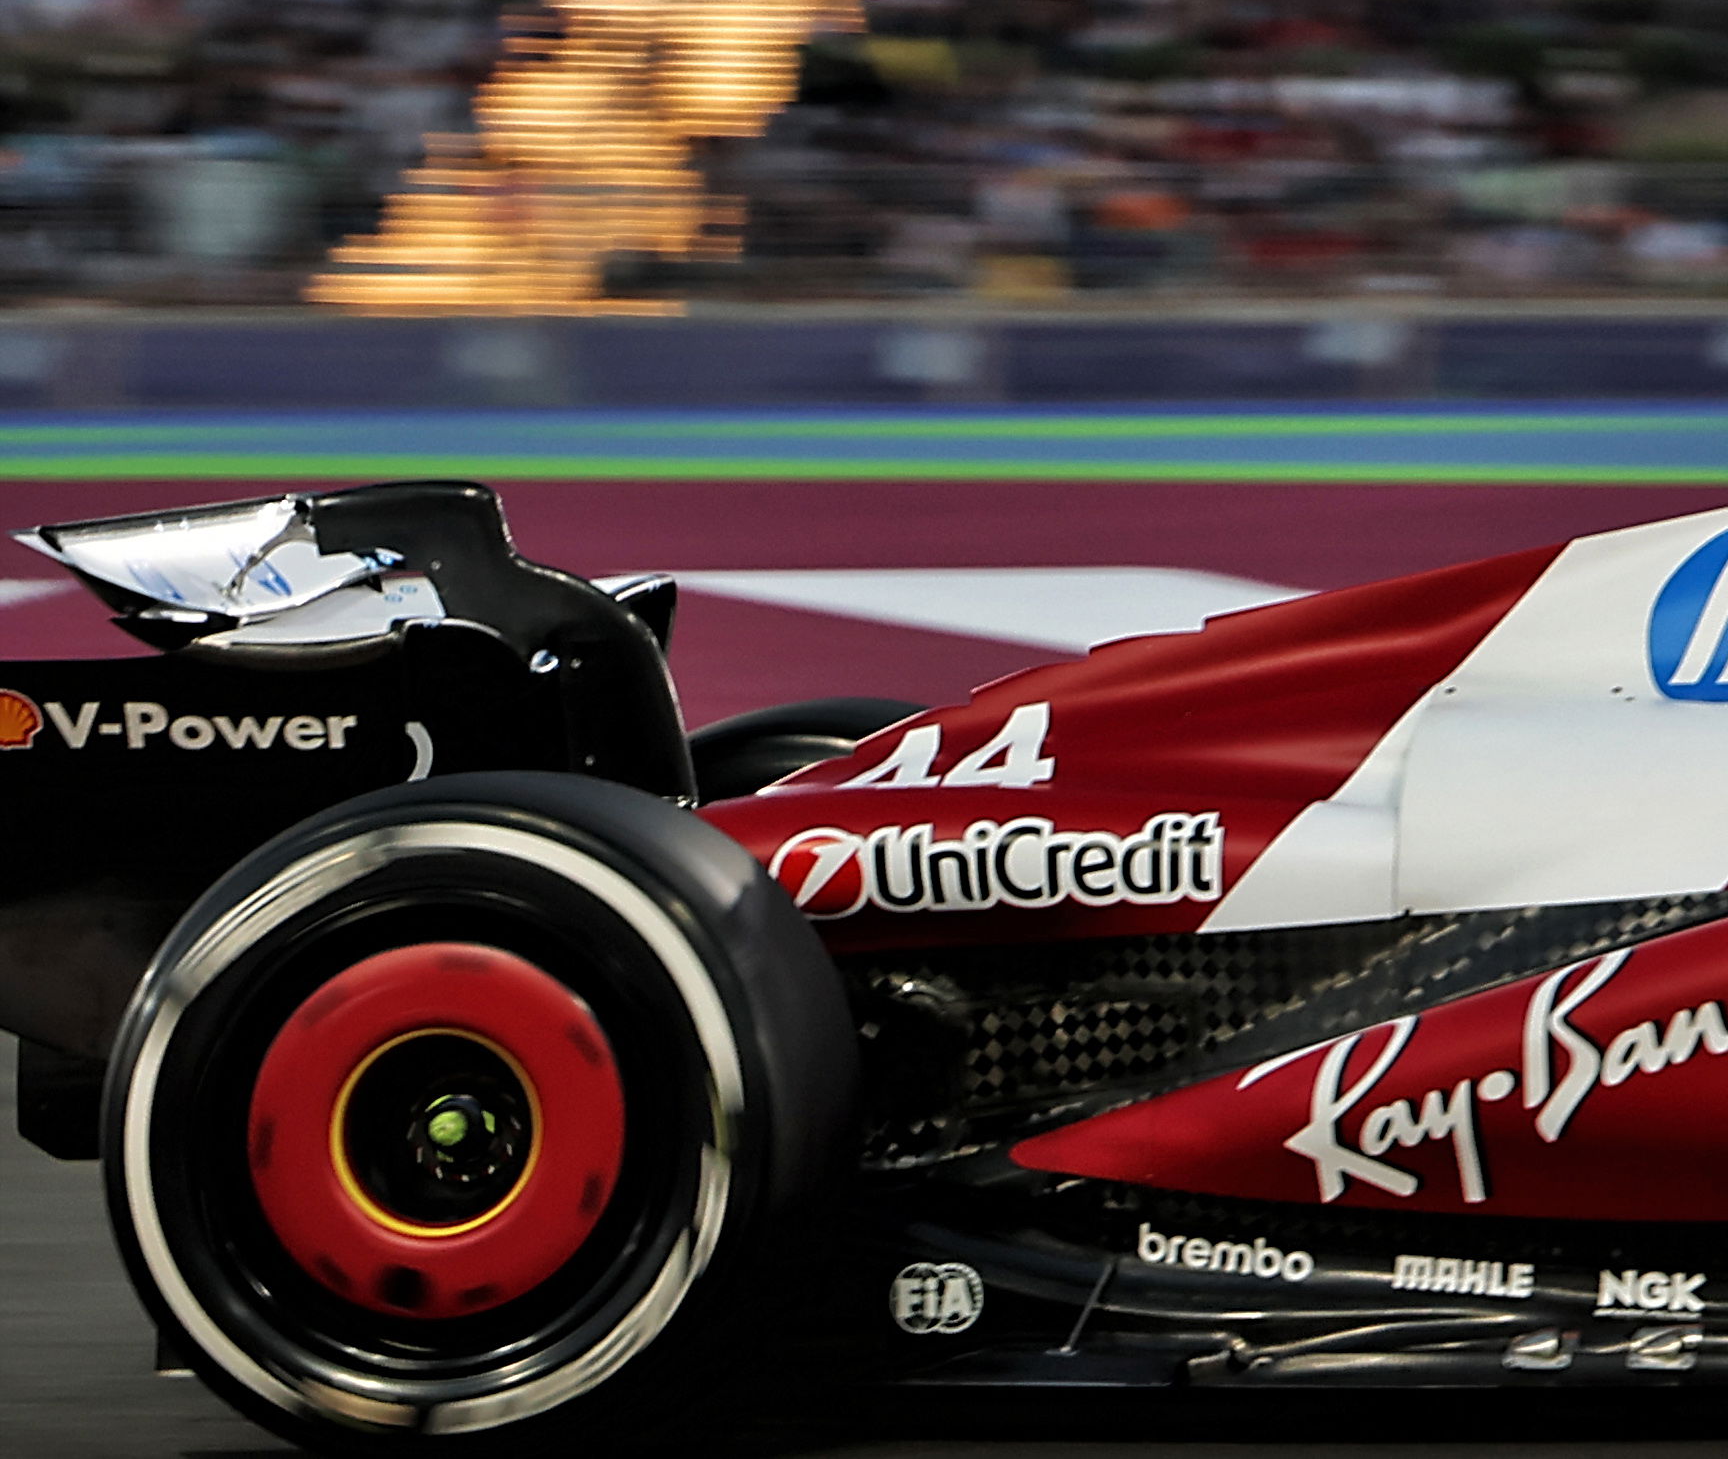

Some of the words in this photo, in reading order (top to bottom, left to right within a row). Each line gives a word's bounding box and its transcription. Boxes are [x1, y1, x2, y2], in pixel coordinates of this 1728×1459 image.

[44, 700, 358, 751] V-Power
[833, 701, 1057, 790] 44
[872, 813, 1220, 909] UniCredit
[1138, 1222, 1316, 1283] brembo
[1391, 1254, 1535, 1298] MAHLE
[1597, 1269, 1707, 1312] NGK
